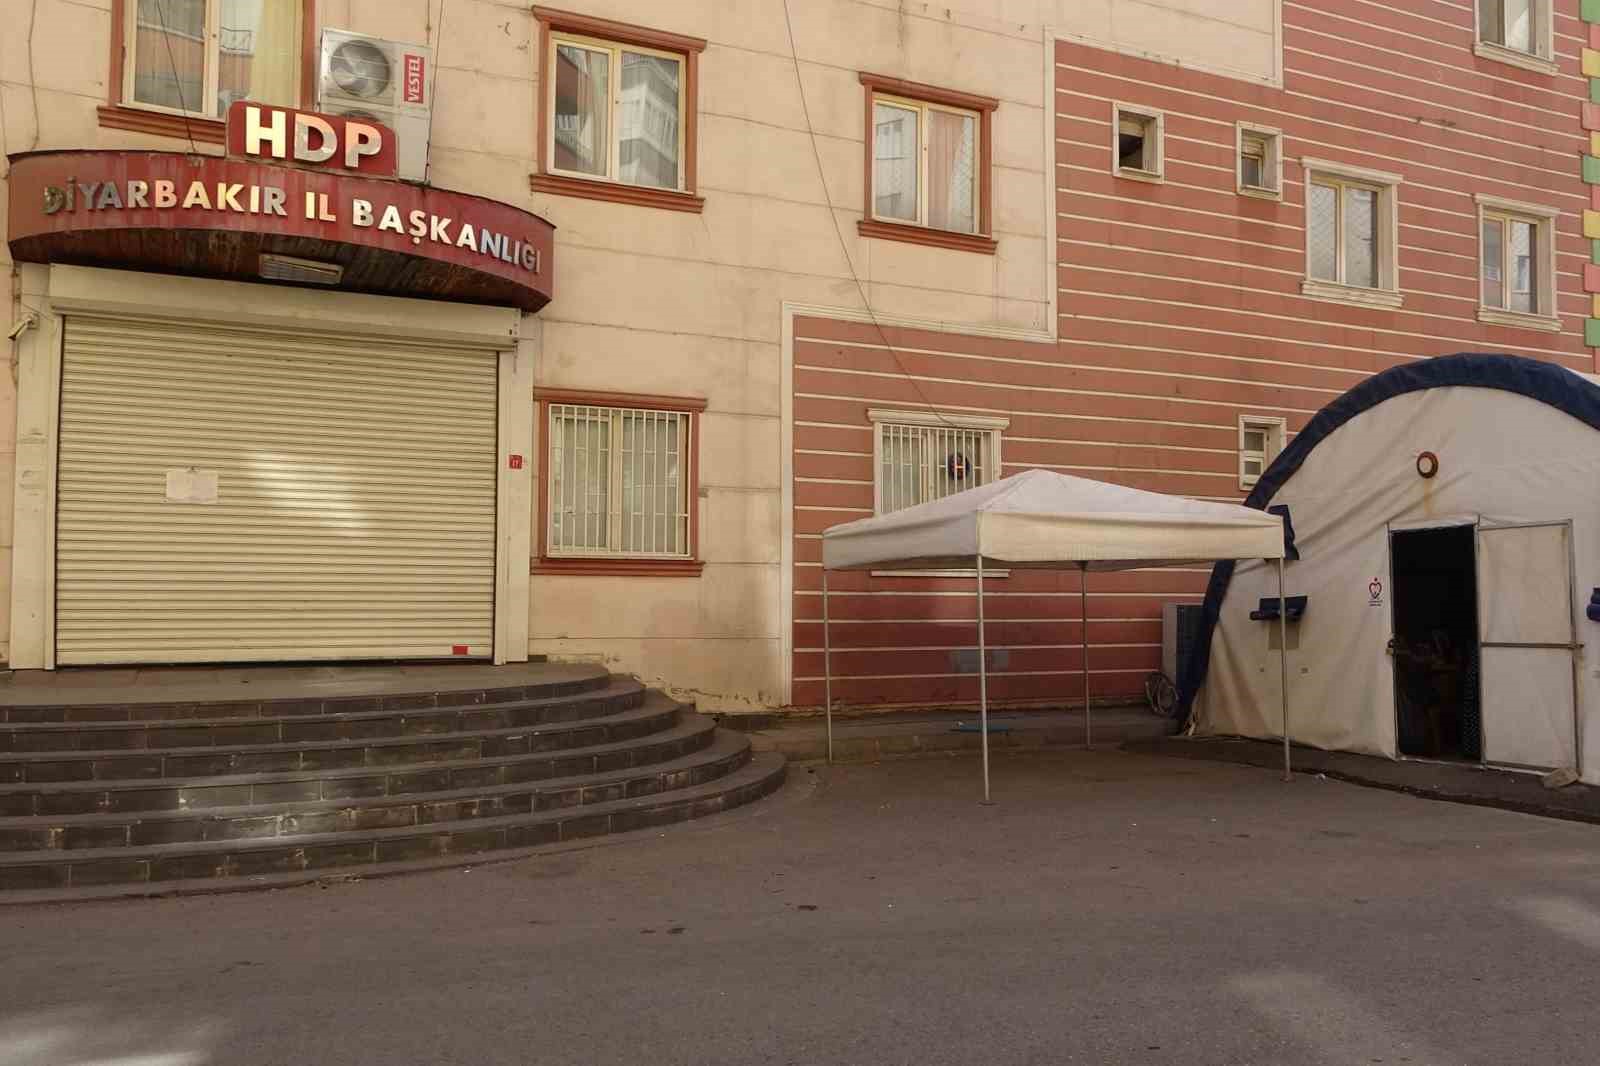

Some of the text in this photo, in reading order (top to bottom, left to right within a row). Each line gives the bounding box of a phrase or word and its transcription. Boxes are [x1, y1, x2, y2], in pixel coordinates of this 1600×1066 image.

[408, 57, 420, 102] VESTEL
[245, 106, 382, 168] HDP
[41, 176, 288, 217] DİYARBAKIR
